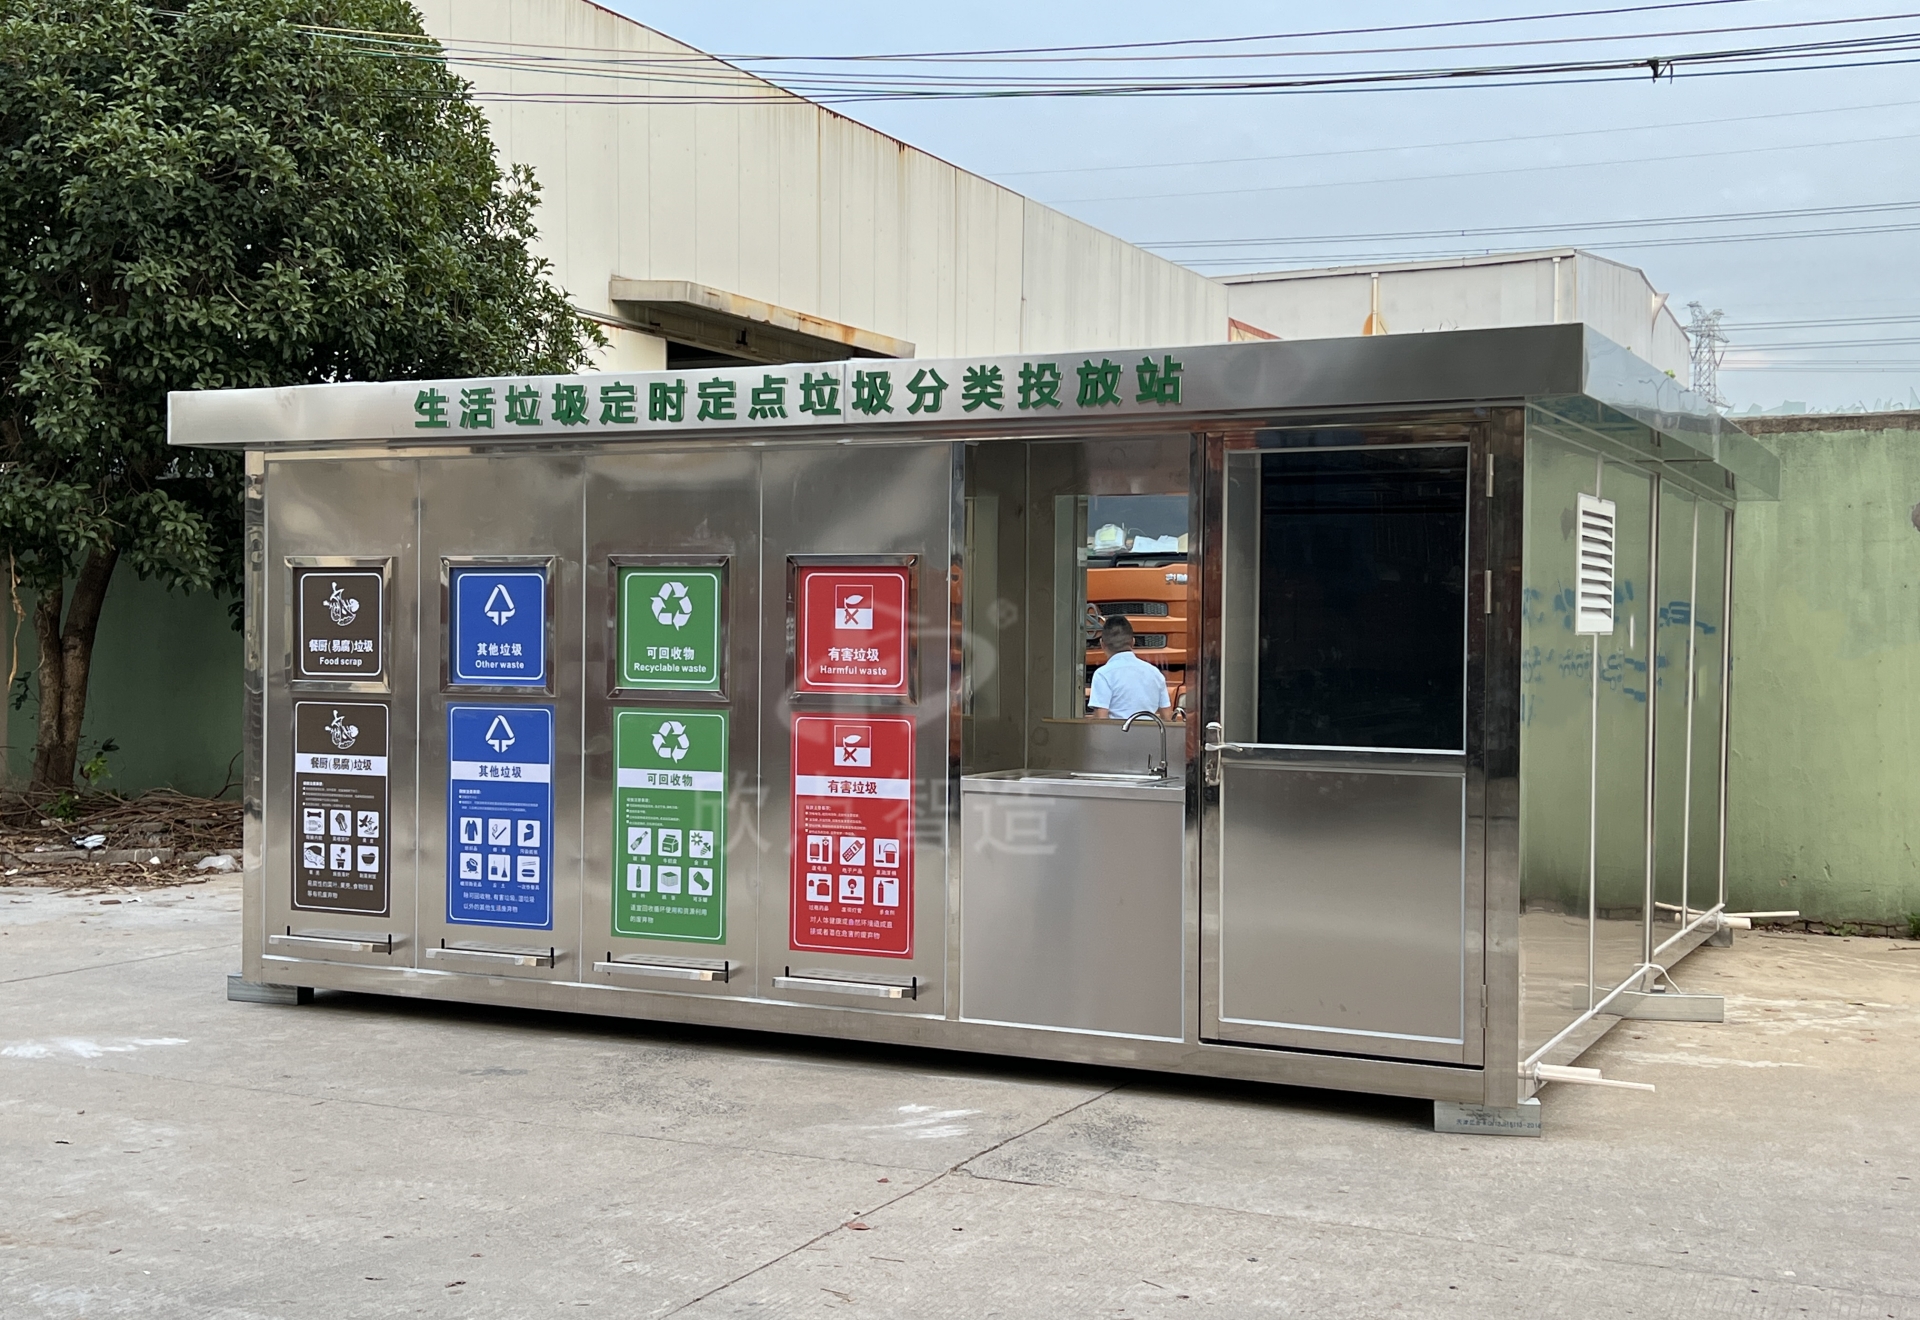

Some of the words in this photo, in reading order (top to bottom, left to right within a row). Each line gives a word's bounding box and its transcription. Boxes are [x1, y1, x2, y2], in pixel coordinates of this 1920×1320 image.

[413, 355, 1185, 430] 生活垃圾定时定点垃圾分类投放站
[477, 642, 522, 656] 其他垃圾
[646, 646, 695, 661] 可回收物
[828, 647, 880, 662] 有害垃圾
[319, 656, 339, 666] Food
[340, 658, 363, 668] scrap
[475, 660, 498, 669] Other
[500, 661, 525, 669] waste
[633, 662, 680, 674] Recyclable
[681, 664, 707, 673] waste
[820, 664, 858, 675] Harmful
[859, 667, 887, 676] waste
[478, 764, 522, 779] 其他垃圾
[646, 772, 693, 787] 可回收物
[827, 779, 878, 795] 有害垃圾
